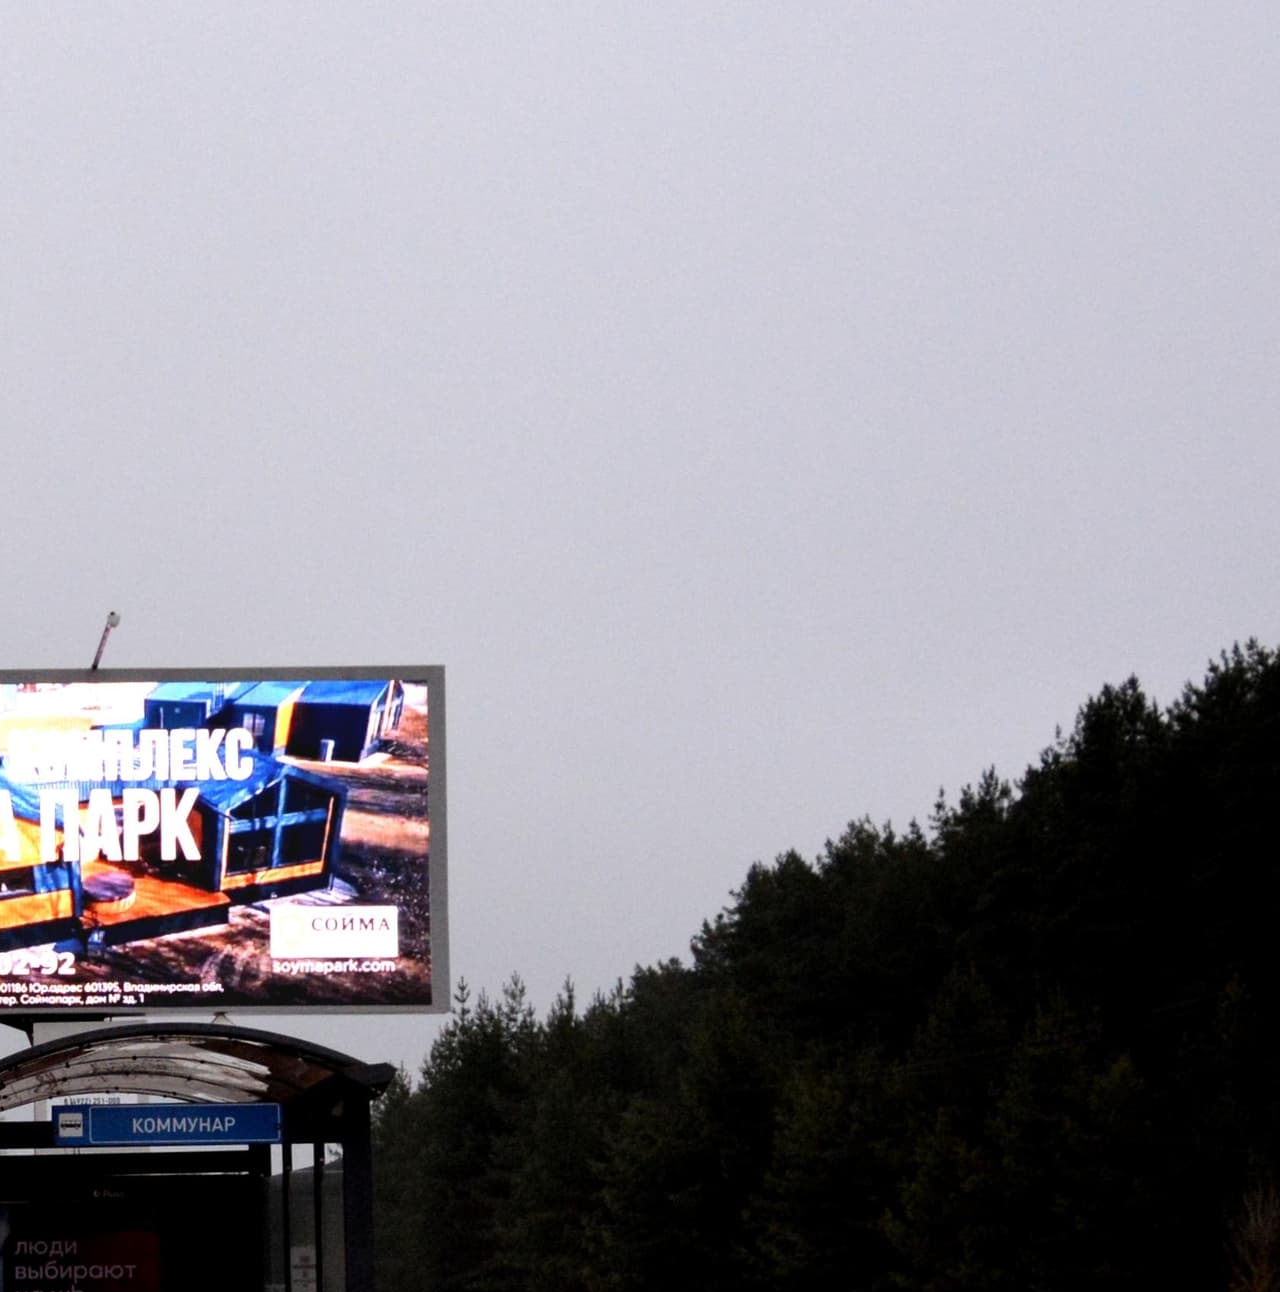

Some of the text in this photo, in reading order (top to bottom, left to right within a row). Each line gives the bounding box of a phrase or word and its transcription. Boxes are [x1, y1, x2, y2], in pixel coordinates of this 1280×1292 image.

[39, 787, 201, 862] ПАРК
[311, 913, 391, 932] СОЙМА
[272, 959, 396, 975] soymapark.com
[132, 1117, 236, 1134] КОММУНАР
[14, 1240, 77, 1258] люди
[14, 1260, 137, 1285] выбирают
